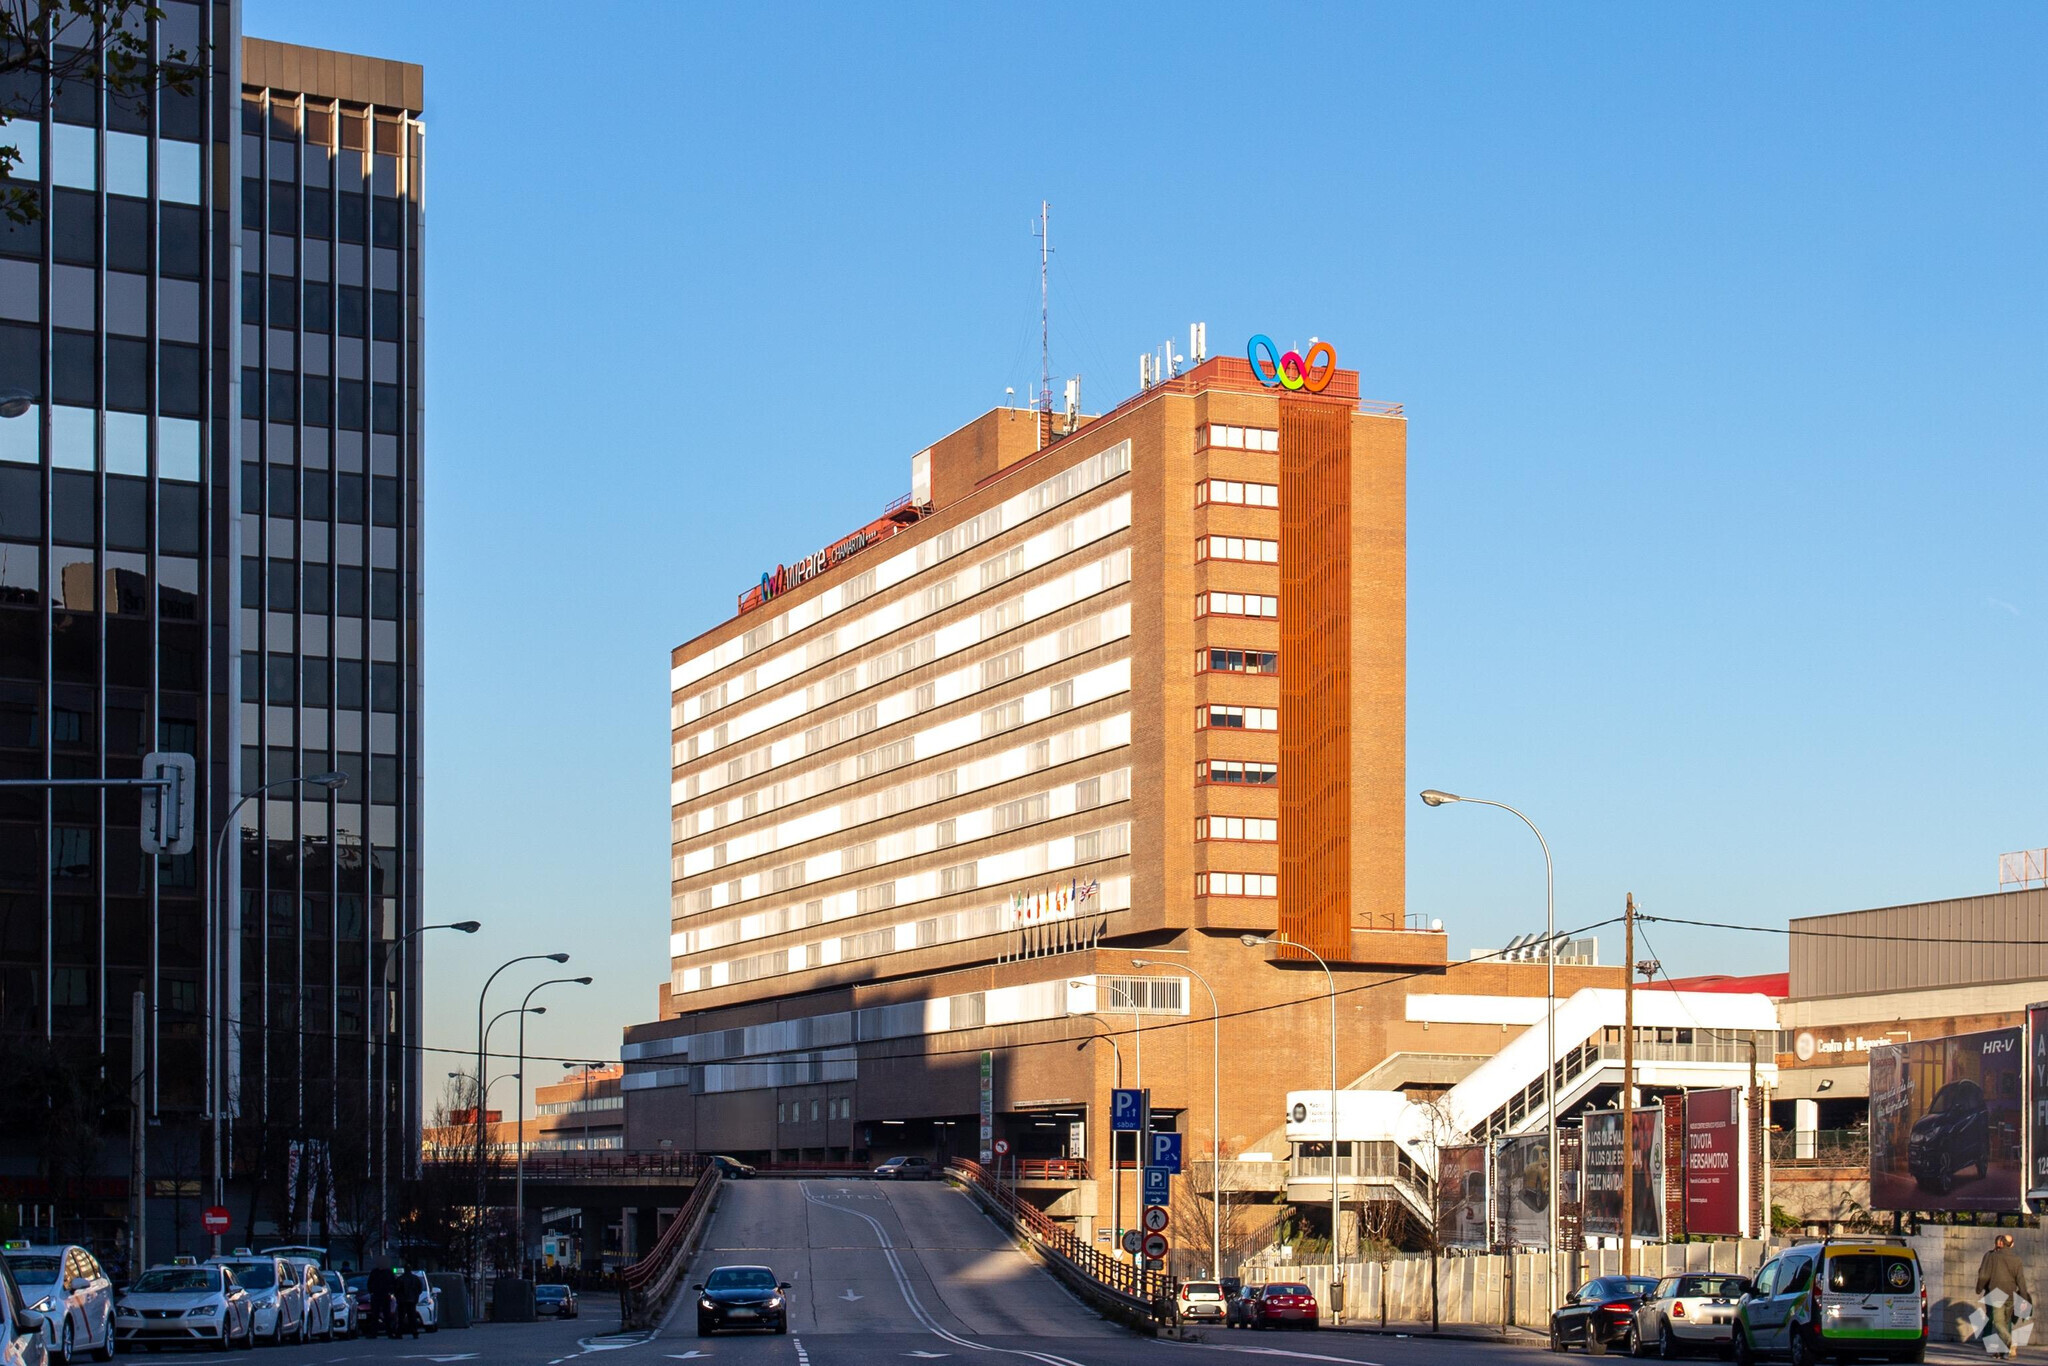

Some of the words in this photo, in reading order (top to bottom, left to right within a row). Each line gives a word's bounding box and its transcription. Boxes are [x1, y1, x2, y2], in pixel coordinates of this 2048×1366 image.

[1817, 1038, 1843, 1053] Centro
[1844, 1037, 1855, 1052] de
[1982, 1038, 2015, 1055] HR-V
[2037, 1033, 2046, 1057] A
[1116, 1092, 1133, 1117] P
[1591, 1130, 1601, 1147] LOS
[1601, 1130, 1613, 1146] QUE
[1690, 1133, 1712, 1149] TOYOTA
[1155, 1135, 1172, 1161] P
[1595, 1150, 1606, 1166] LOS
[1605, 1150, 1617, 1166] QUE
[1690, 1152, 1729, 1169] HERSAMOTOR
[1151, 1172, 1162, 1187] P
[1587, 1173, 1602, 1191] FELIZ
[1602, 1173, 1625, 1191] NAVIDA
